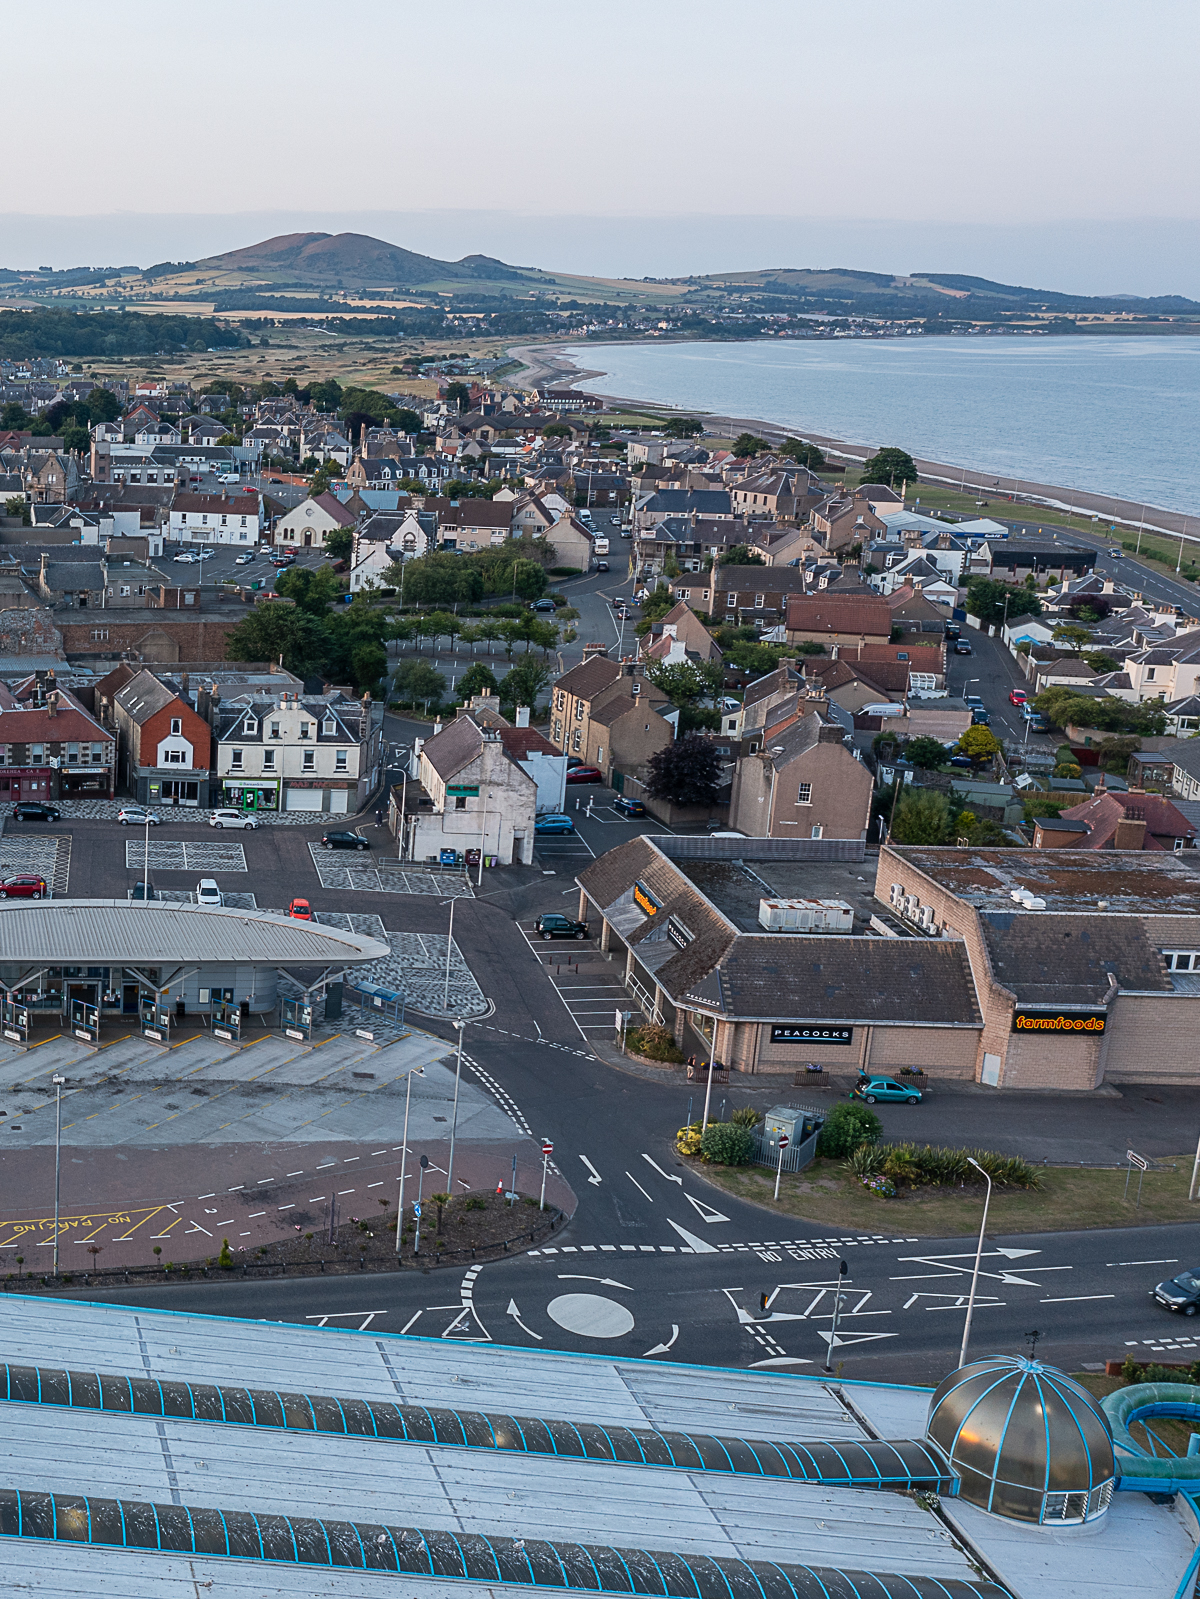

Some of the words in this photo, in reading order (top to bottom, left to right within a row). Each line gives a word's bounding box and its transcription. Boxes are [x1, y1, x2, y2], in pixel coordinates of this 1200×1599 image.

[634, 886, 657, 916] farmfood
[1016, 1015, 1105, 1030] farmfoods
[774, 1029, 849, 1038] PEACOCKS
[13, 1219, 93, 1232] PARKING
[108, 1215, 131, 1224] NO
[756, 1251, 783, 1263] NO
[787, 1248, 841, 1261] ENTRY
